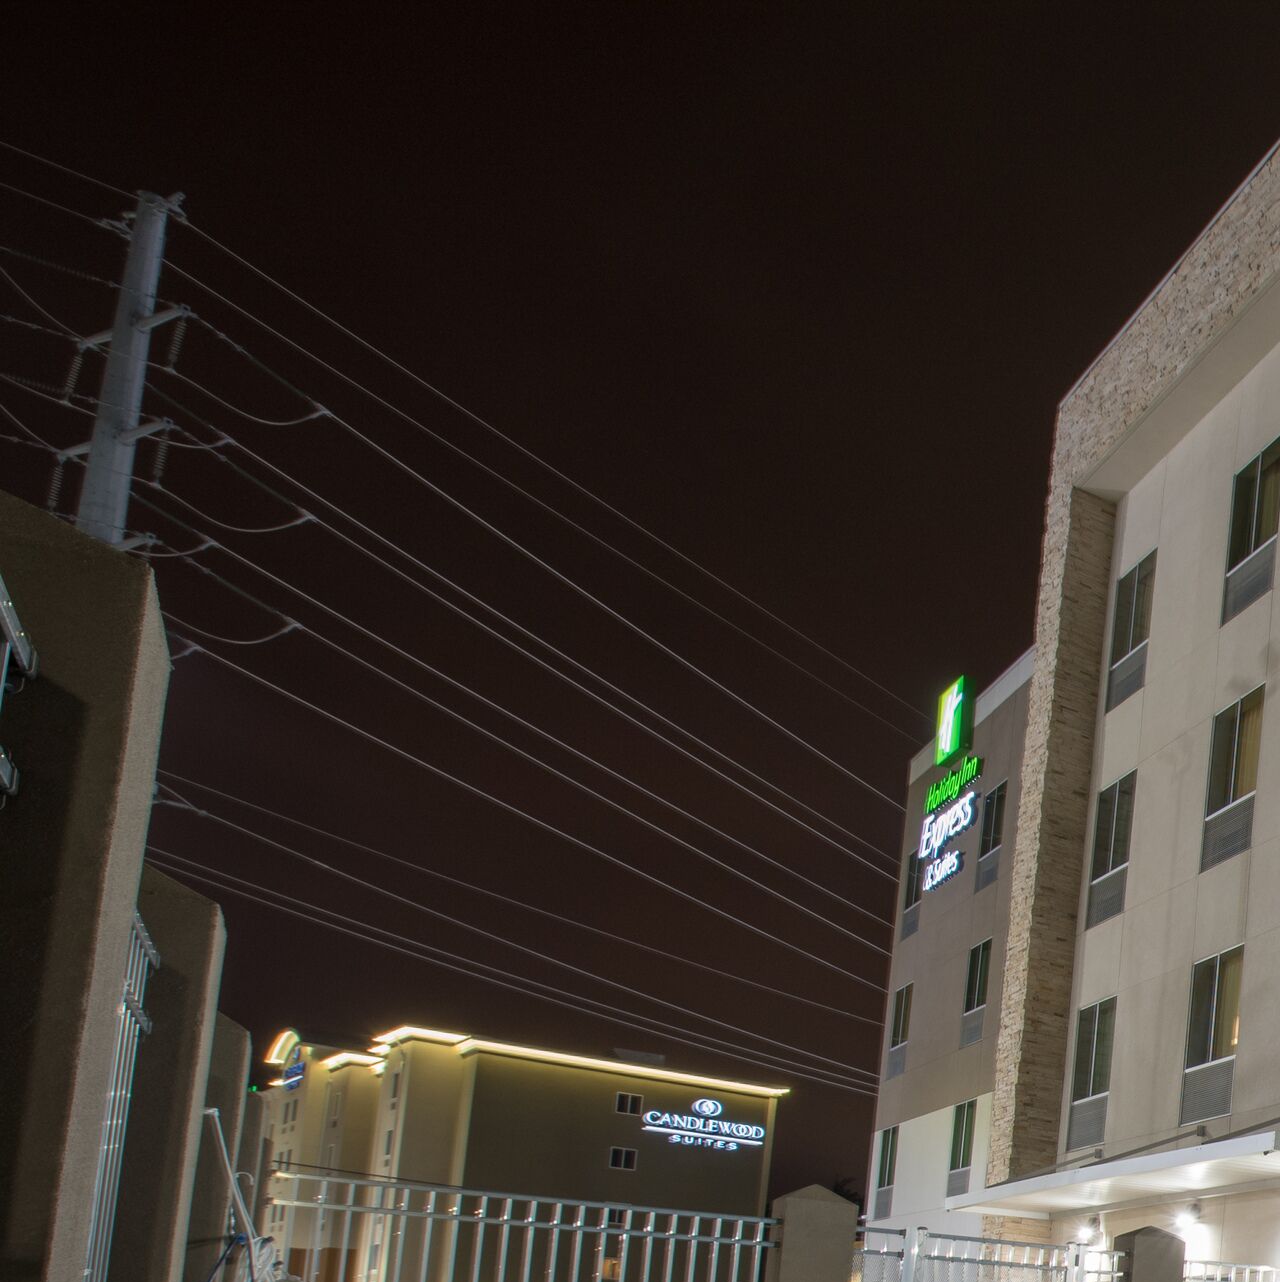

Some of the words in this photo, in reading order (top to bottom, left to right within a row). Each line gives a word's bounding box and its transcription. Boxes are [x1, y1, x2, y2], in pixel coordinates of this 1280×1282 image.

[925, 770, 961, 813] Holiday
[961, 756, 978, 785] Inn
[918, 791, 975, 859] Express
[643, 1111, 765, 1139] CANDLEWOOD
[669, 1134, 738, 1151] SUITES
